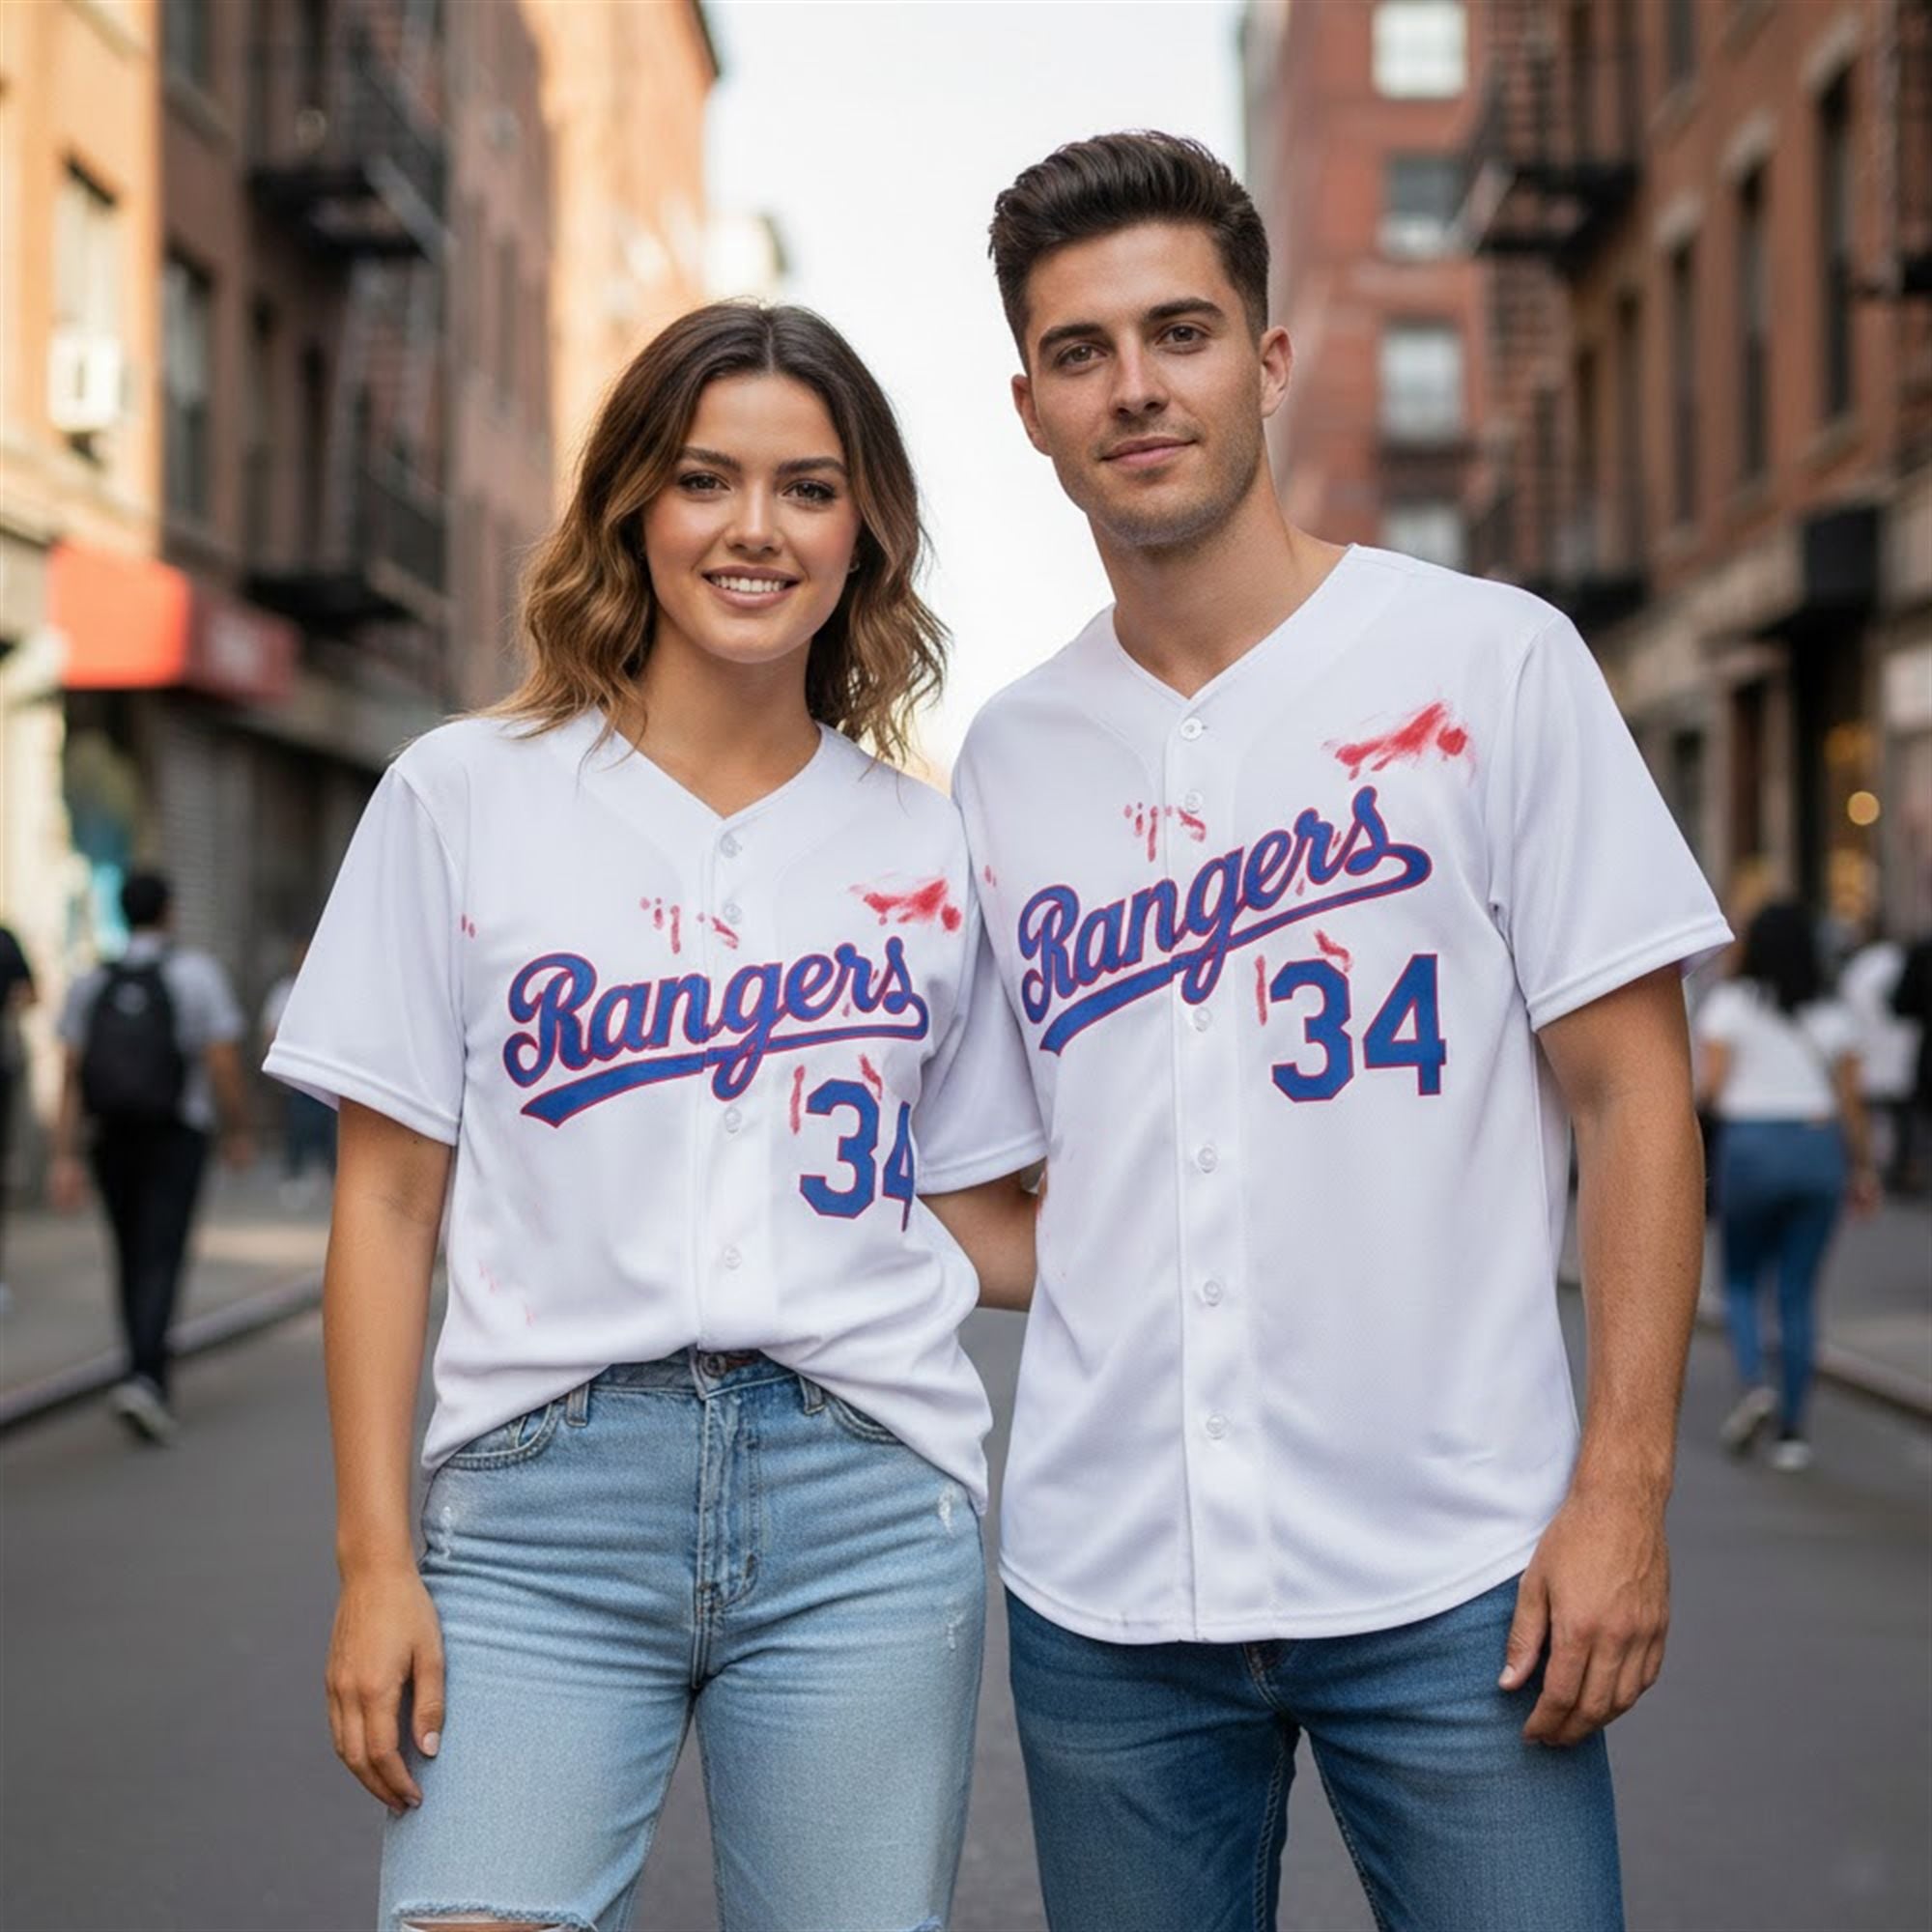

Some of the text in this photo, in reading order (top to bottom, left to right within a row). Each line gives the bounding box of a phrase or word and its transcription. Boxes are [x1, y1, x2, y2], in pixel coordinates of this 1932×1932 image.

[1017, 784, 1434, 1057] Rangers
[502, 936, 929, 1127] Rangers
[1269, 953, 1447, 1102] 34
